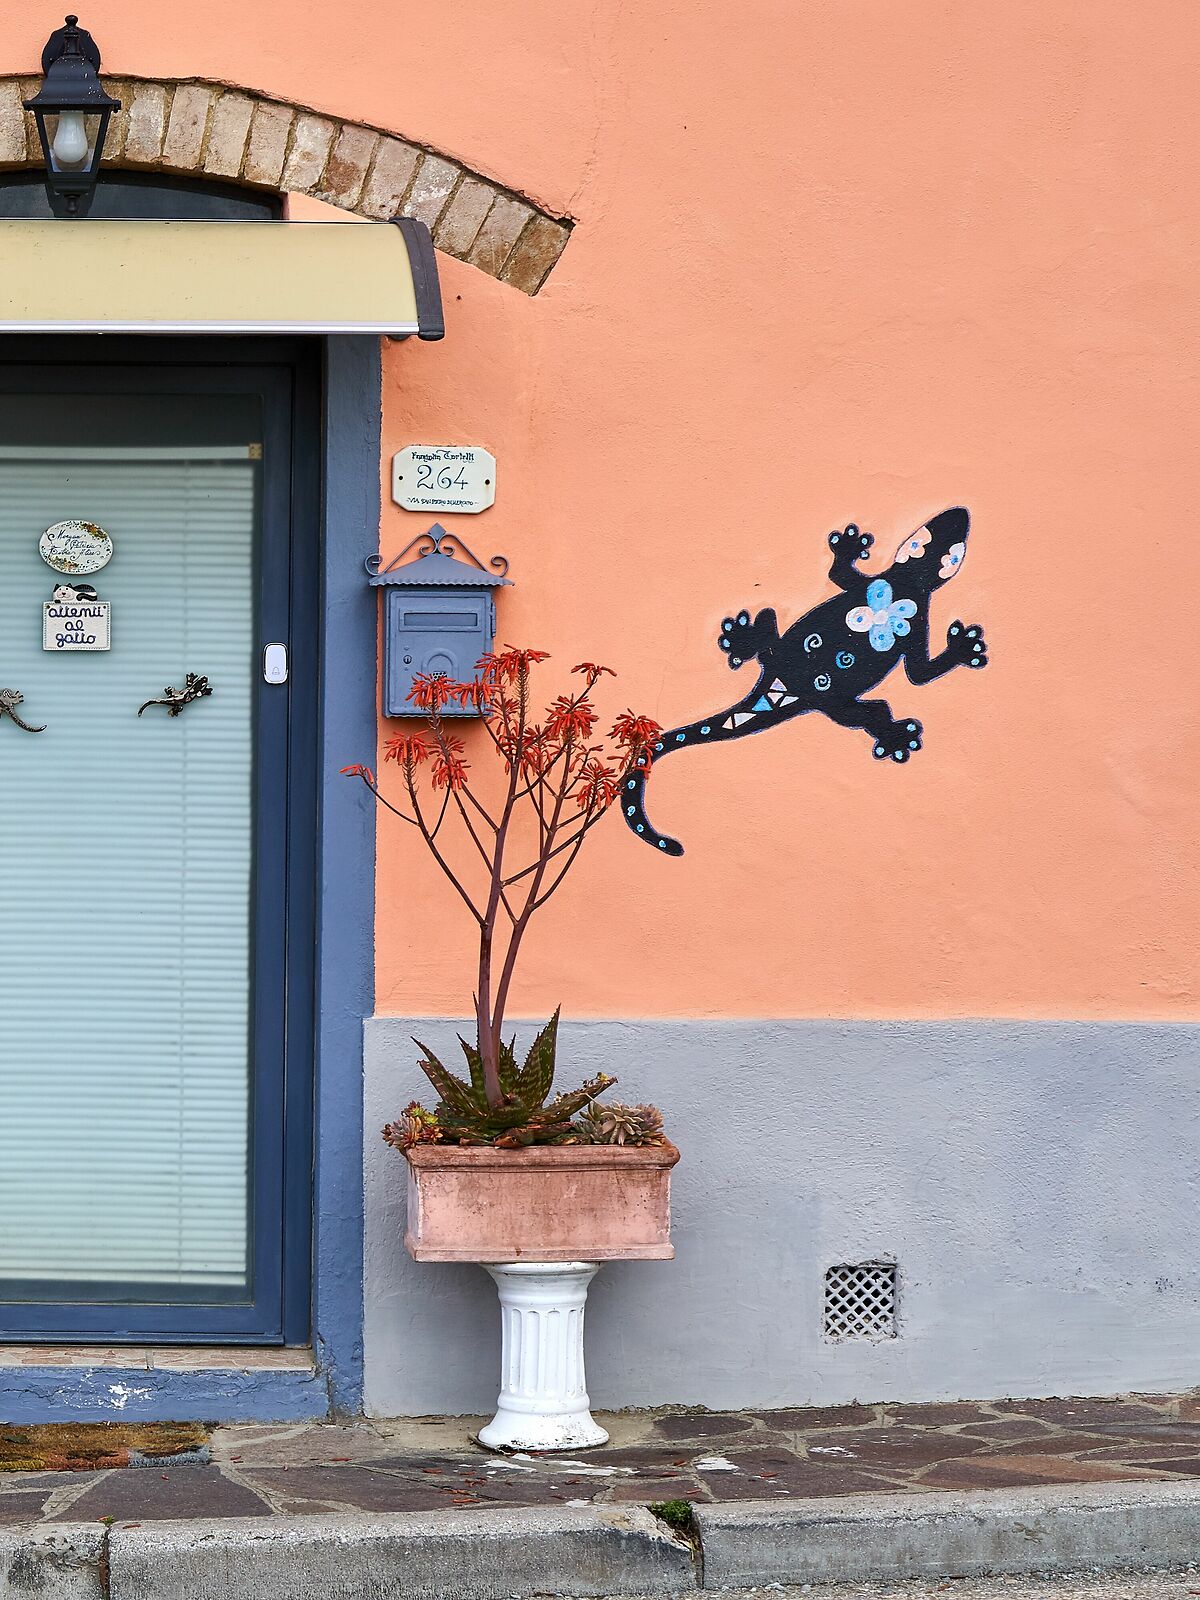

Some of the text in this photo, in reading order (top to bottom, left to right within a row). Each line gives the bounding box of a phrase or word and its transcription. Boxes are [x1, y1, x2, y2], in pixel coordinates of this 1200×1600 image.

[417, 464, 468, 490] 264
[48, 607, 103, 618] attenti
[64, 620, 85, 632] al
[56, 633, 96, 647] gatto
